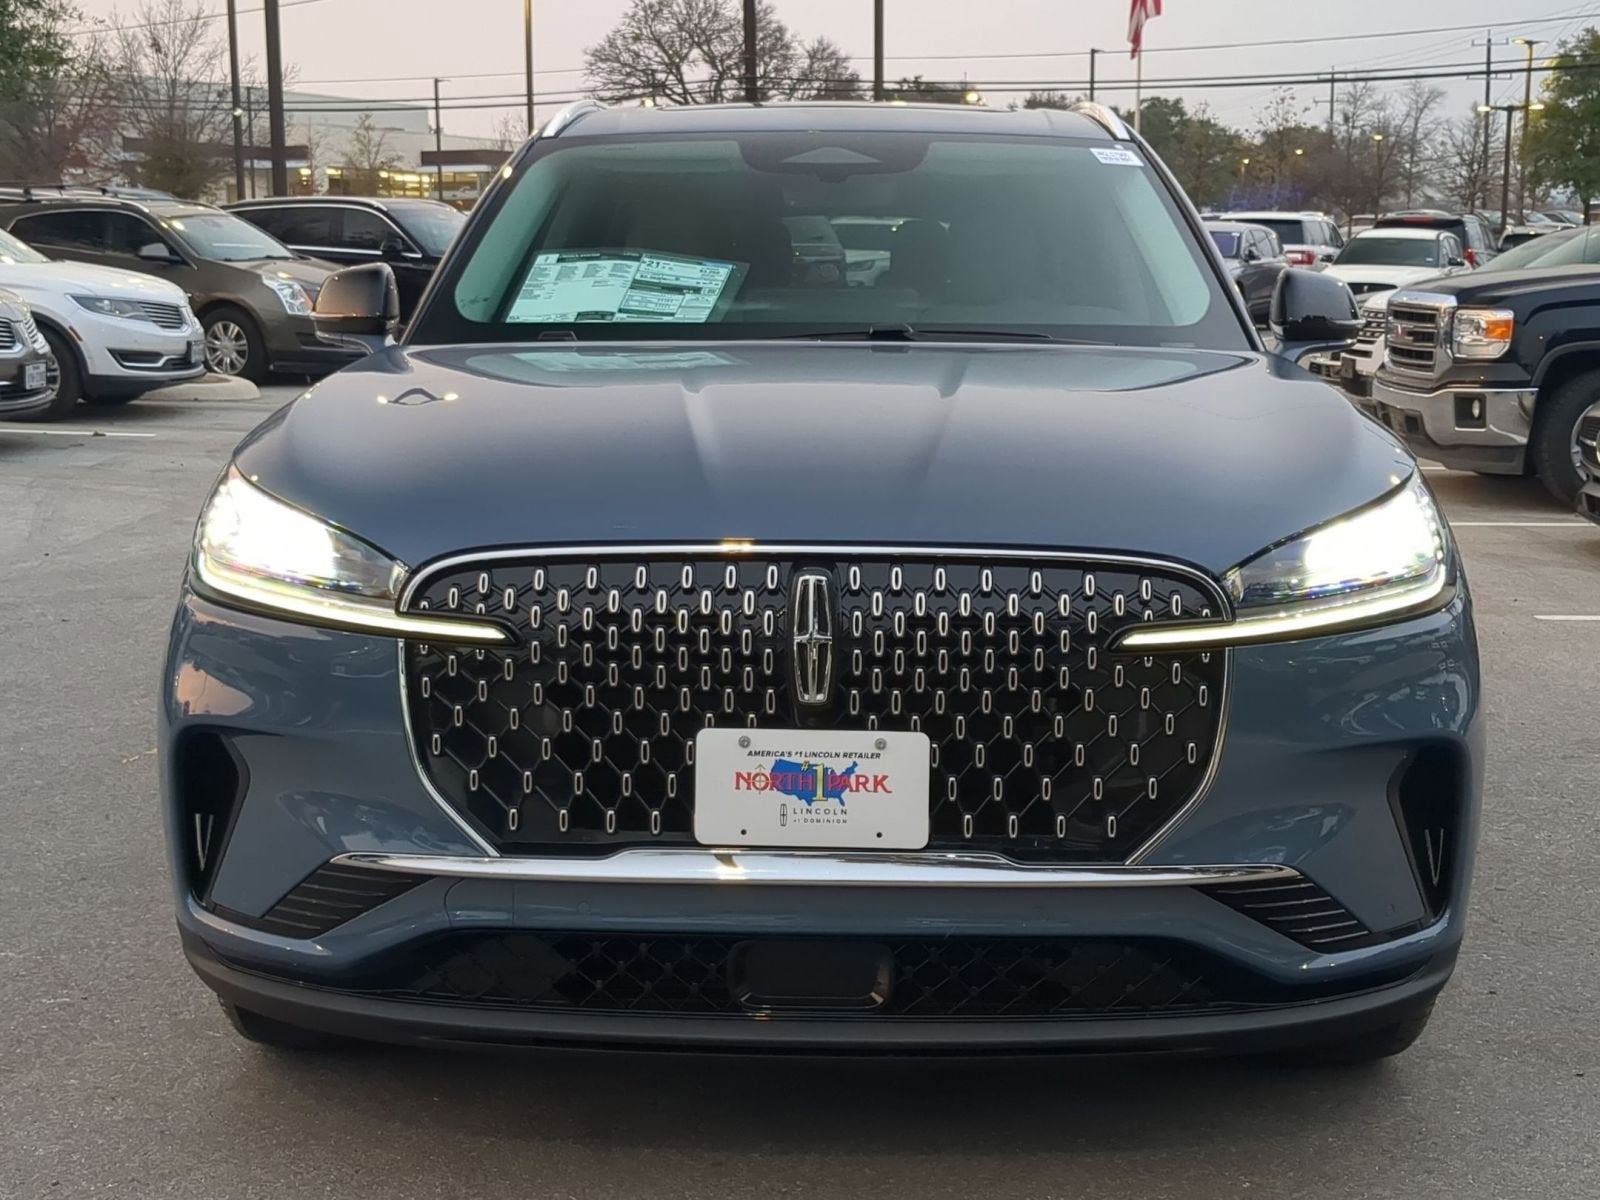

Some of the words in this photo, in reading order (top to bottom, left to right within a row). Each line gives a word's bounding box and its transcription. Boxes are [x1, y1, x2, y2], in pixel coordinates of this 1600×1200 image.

[747, 750, 793, 758] AMERICA'S
[804, 751, 841, 759] LINCOLN
[842, 752, 881, 760] RETAILER
[735, 771, 814, 791] NORTH
[827, 773, 893, 794] PARK
[801, 760, 829, 802] #1
[793, 807, 848, 816] LINCOLN
